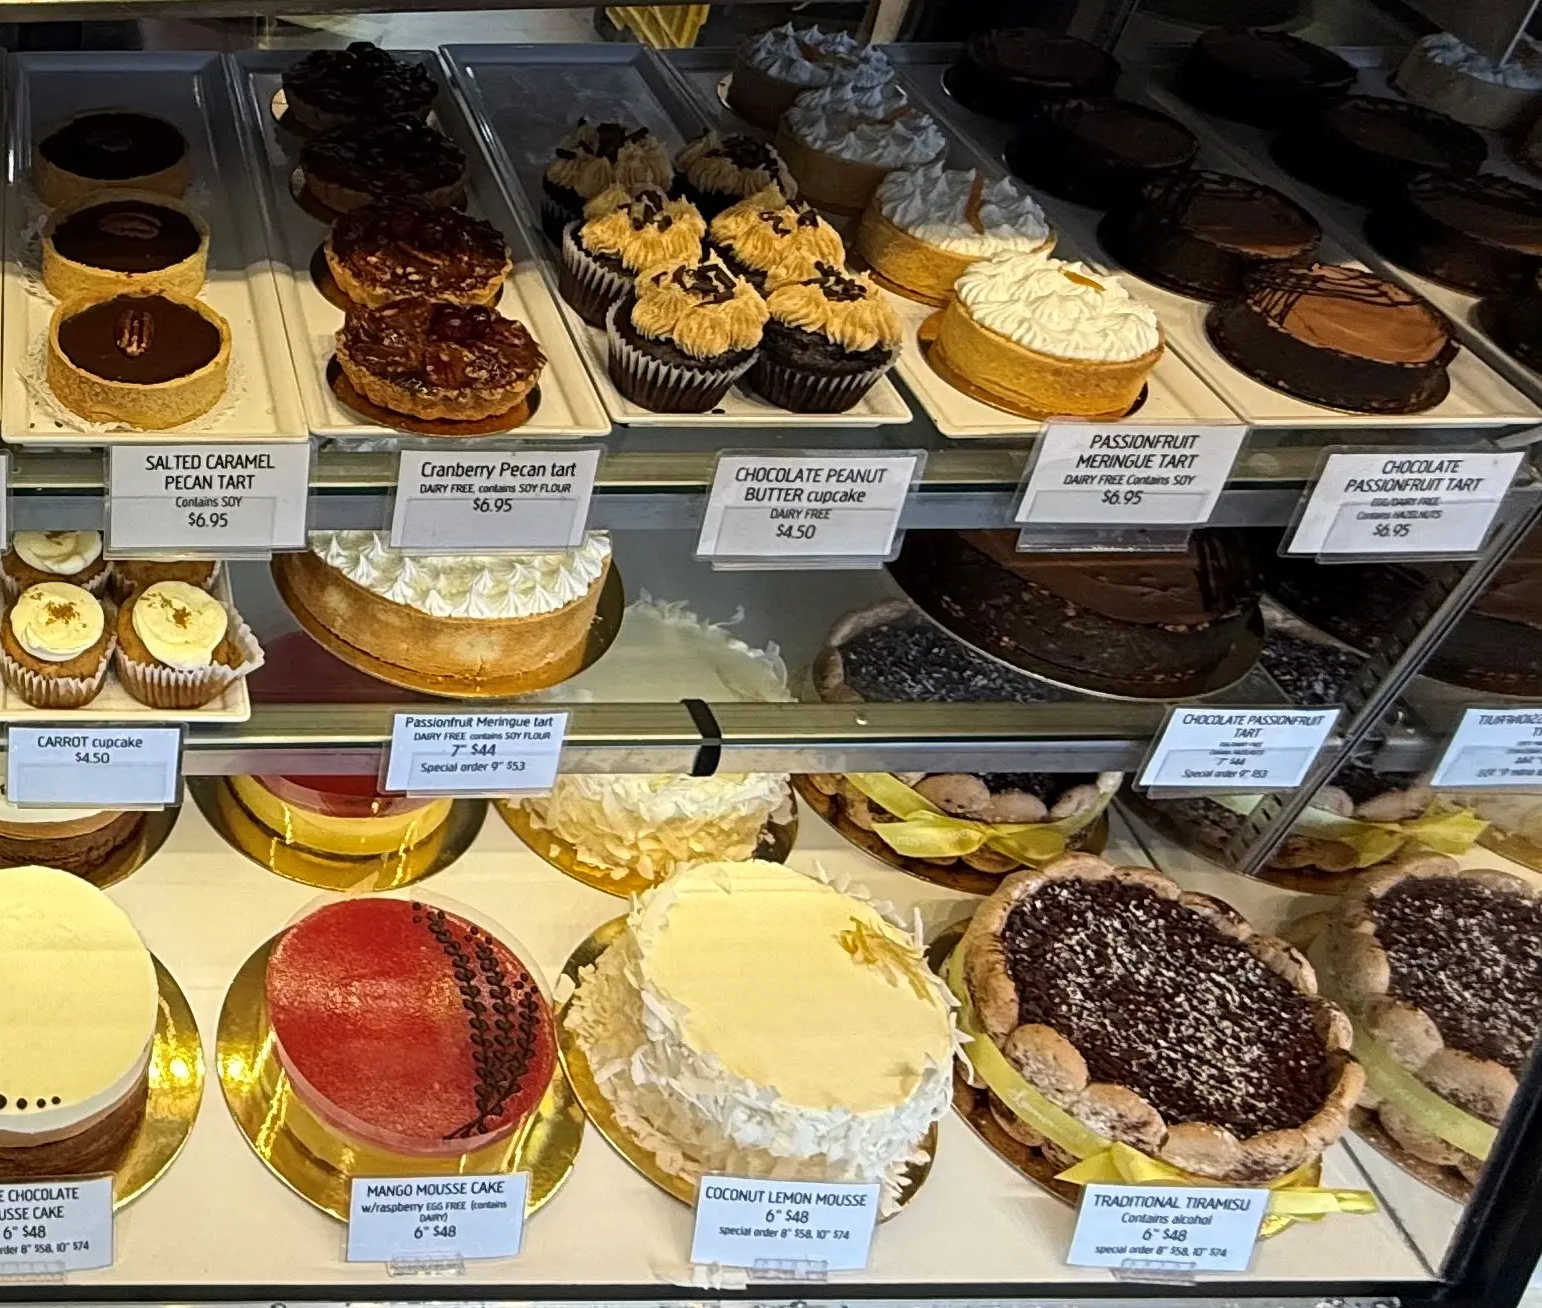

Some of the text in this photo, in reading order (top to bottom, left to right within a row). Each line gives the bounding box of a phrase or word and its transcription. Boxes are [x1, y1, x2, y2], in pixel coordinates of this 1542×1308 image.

[1089, 435, 1201, 449] PASSIONFRUIT
[145, 454, 276, 471] SALTED CARAMEL
[1075, 454, 1199, 469] MERINGUE TART
[1382, 460, 1463, 474] CHOCOLATE
[421, 461, 577, 479] Cranberry Pecan tart
[735, 467, 888, 483] CHOCOLATE PEANUT
[164, 475, 256, 490] PECAN TART
[1063, 474, 1196, 485] DAIRY FREE Contains SOY
[1344, 478, 1484, 492] PASSIONFRUIT TART
[419, 484, 449, 494] DAIRY
[478, 484, 516, 493] contains
[518, 484, 538, 492] SOY
[540, 484, 571, 492] FLOUR
[744, 488, 867, 504] BUTTER cupcake
[175, 496, 243, 508] Contains SOY
[472, 497, 512, 512] $6.95
[1101, 490, 1144, 505] $6.95
[188, 512, 228, 528] $6.95
[770, 508, 832, 519] DAIRY FREE
[775, 524, 816, 539] $4.50
[1372, 523, 1411, 537] $6.95
[405, 717, 554, 728] Passionfruit Meringue tart
[1182, 714, 1325, 726] CHOCOLATE PASSIONFRUIT
[414, 732, 441, 741] DAIRY
[443, 732, 466, 740] FREE
[505, 732, 522, 740] SOY
[1233, 728, 1263, 738] TART
[37, 736, 143, 748] CARROT cupcake
[451, 743, 496, 757] 7" $44
[75, 752, 110, 763] $4.50
[420, 761, 526, 773] Special order 9" $53
[7, 1187, 79, 1203] CHOCOLATE
[366, 1181, 505, 1198] MANGO MOUSSE CAKE
[705, 1186, 868, 1207] COCONUT LEMON MOUSSE
[361, 1200, 507, 1213] w/raspberry EGG FREE (contains
[1094, 1194, 1251, 1211] TRADITIONAL TIRAMISU
[32, 1206, 64, 1220] CAKE
[419, 1213, 448, 1223] DAIRY)
[765, 1209, 809, 1224] 6" $48
[1121, 1212, 1213, 1225] Contains alcohol
[3, 1225, 46, 1240] 6" $48
[414, 1225, 457, 1239] 6" $48
[1142, 1228, 1188, 1242] 6" $48
